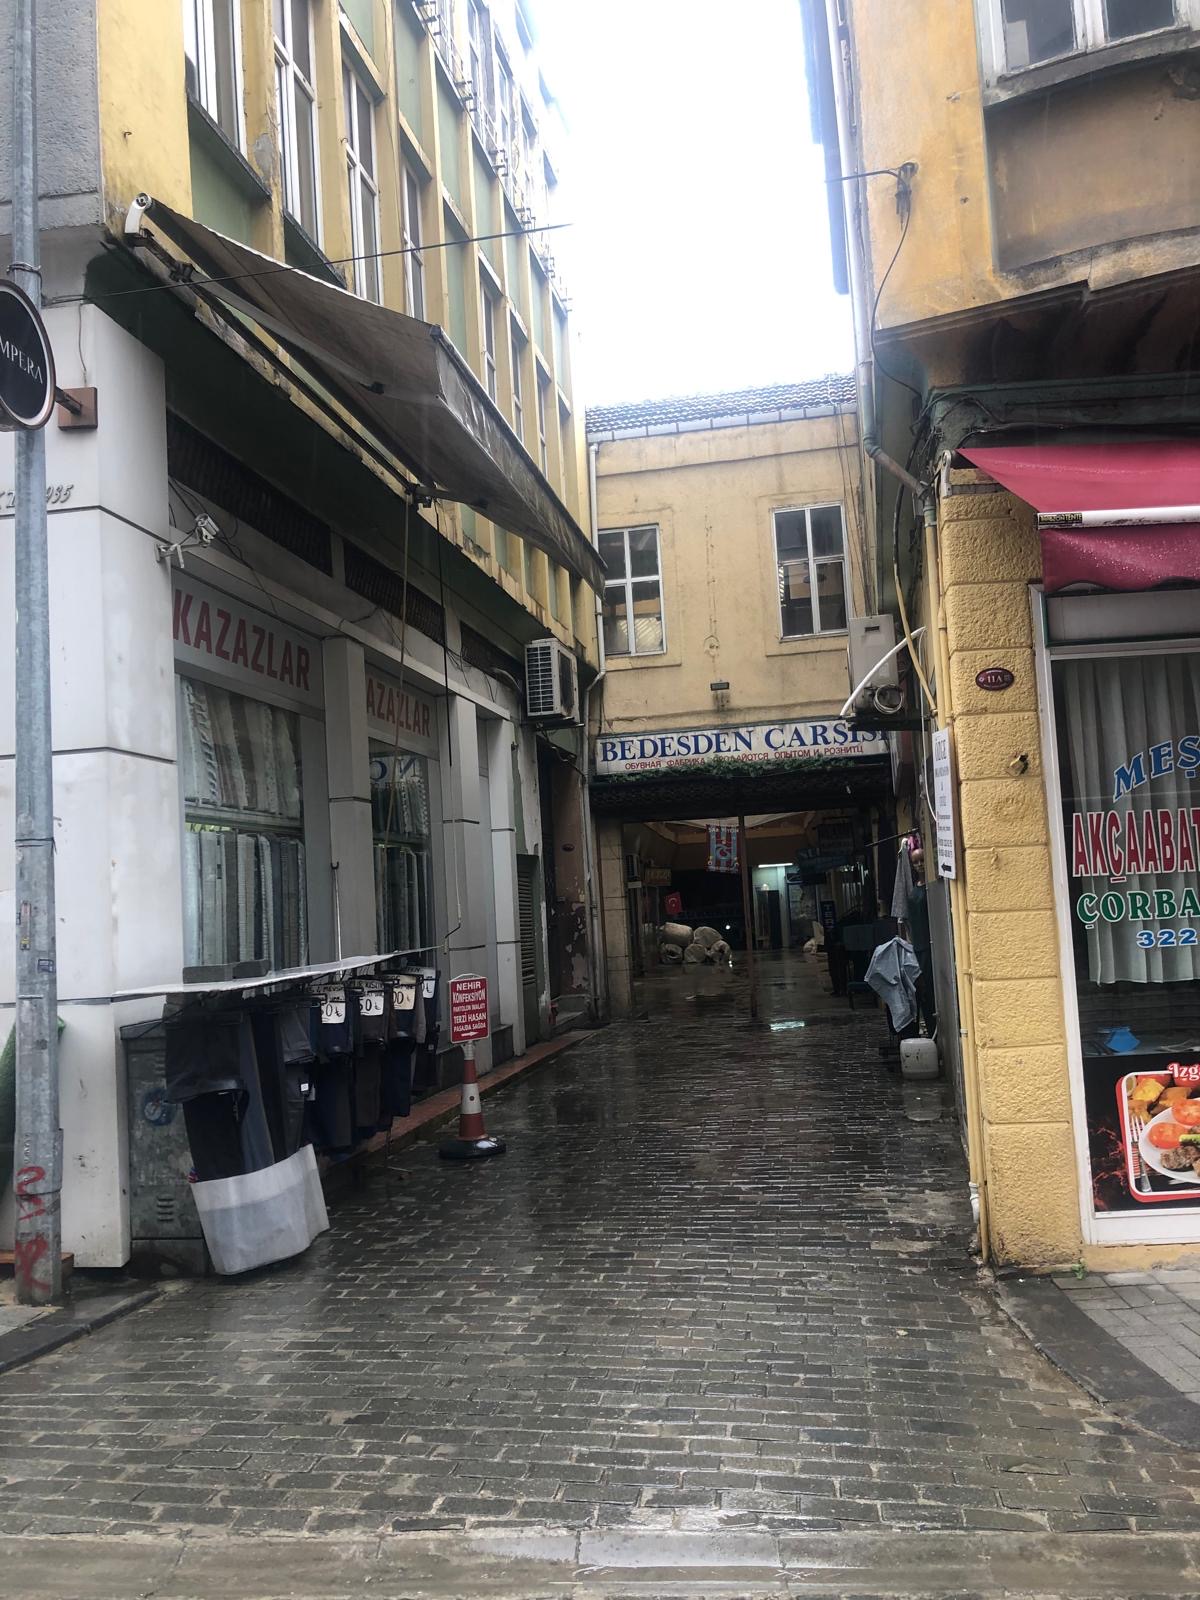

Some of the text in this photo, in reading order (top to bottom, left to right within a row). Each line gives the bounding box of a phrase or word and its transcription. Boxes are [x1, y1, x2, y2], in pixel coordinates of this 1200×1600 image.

[173, 589, 310, 691] KAZAZLAR
[600, 730, 754, 762] BEDESDEN
[625, 760, 662, 770] ОБУВНАЯ
[1077, 887, 1200, 929] ÇORBA
[1136, 927, 1197, 949] 322
[1167, 1062, 1200, 1082] Izg
